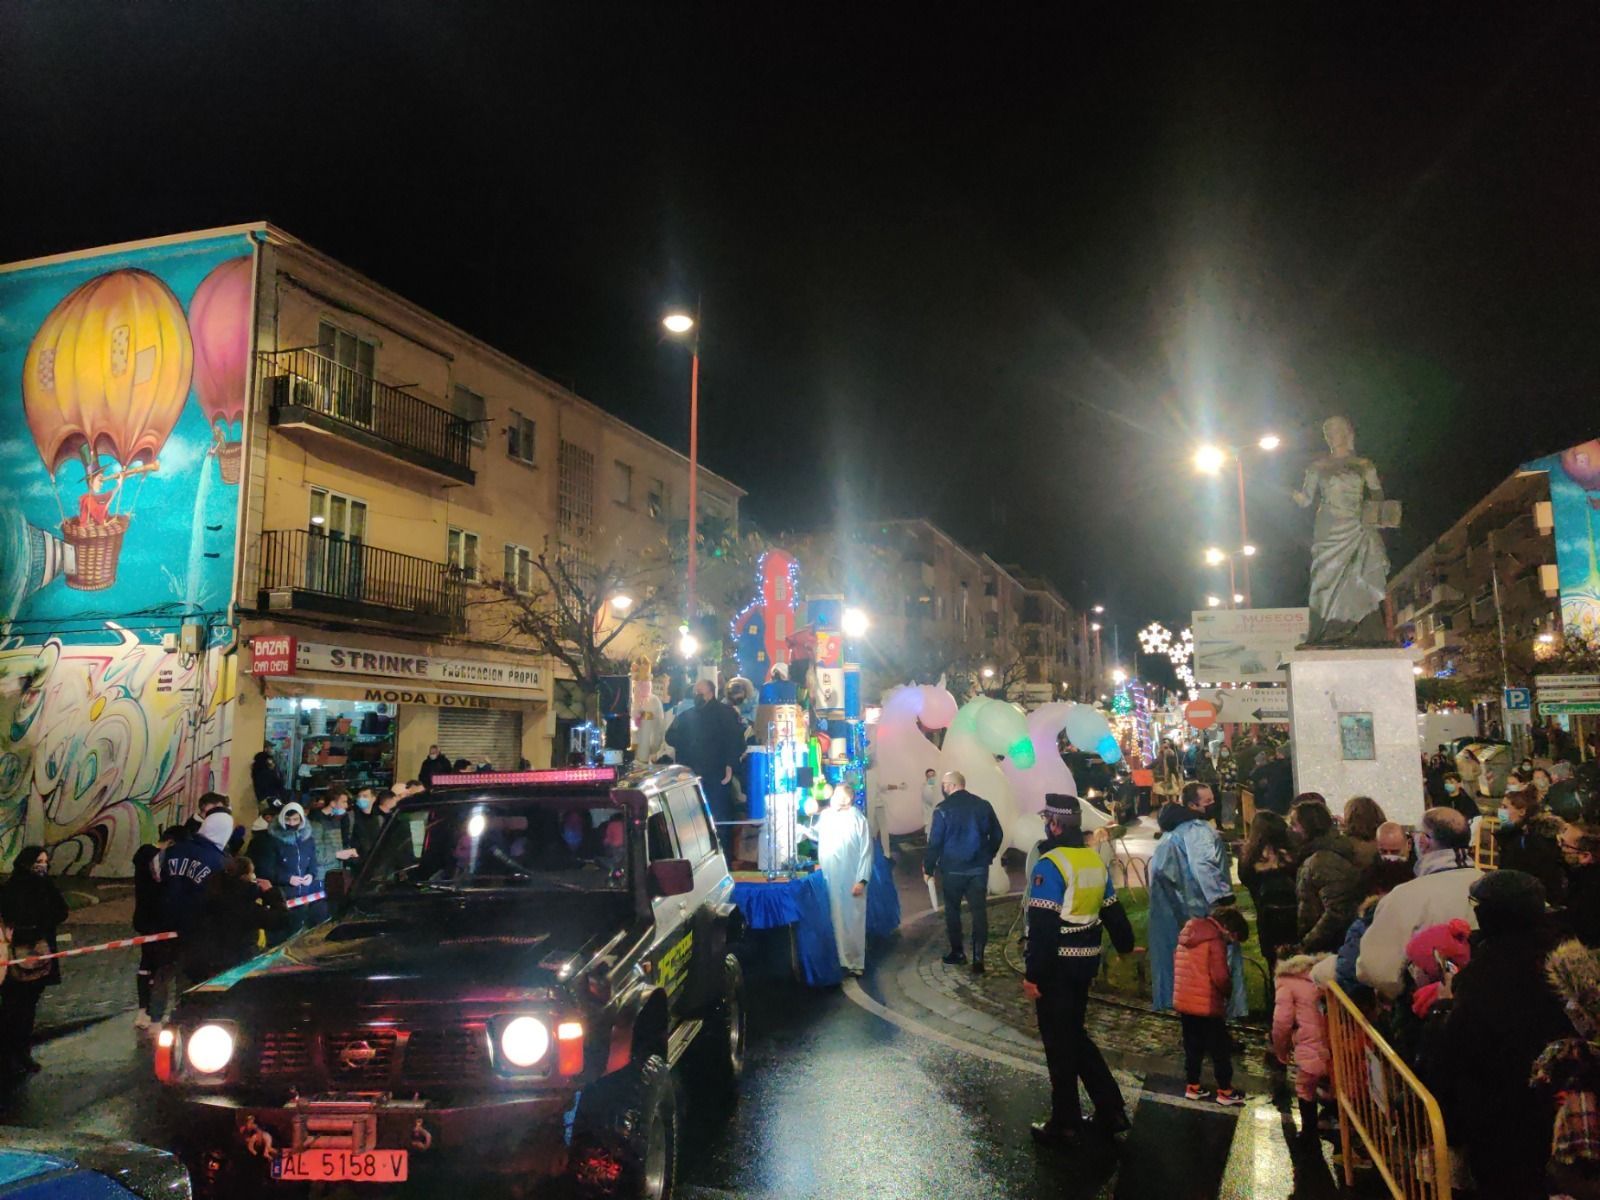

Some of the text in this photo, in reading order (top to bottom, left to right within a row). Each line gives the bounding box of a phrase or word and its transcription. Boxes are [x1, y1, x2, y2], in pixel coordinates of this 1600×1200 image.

[255, 640, 290, 656] BAZAR
[330, 649, 429, 676] STRINKE
[508, 669, 539, 685] PROPIA
[364, 688, 427, 704] MODA
[284, 1154, 309, 1176] AL
[322, 1153, 375, 1177] 5158
[391, 1154, 402, 1177] V
